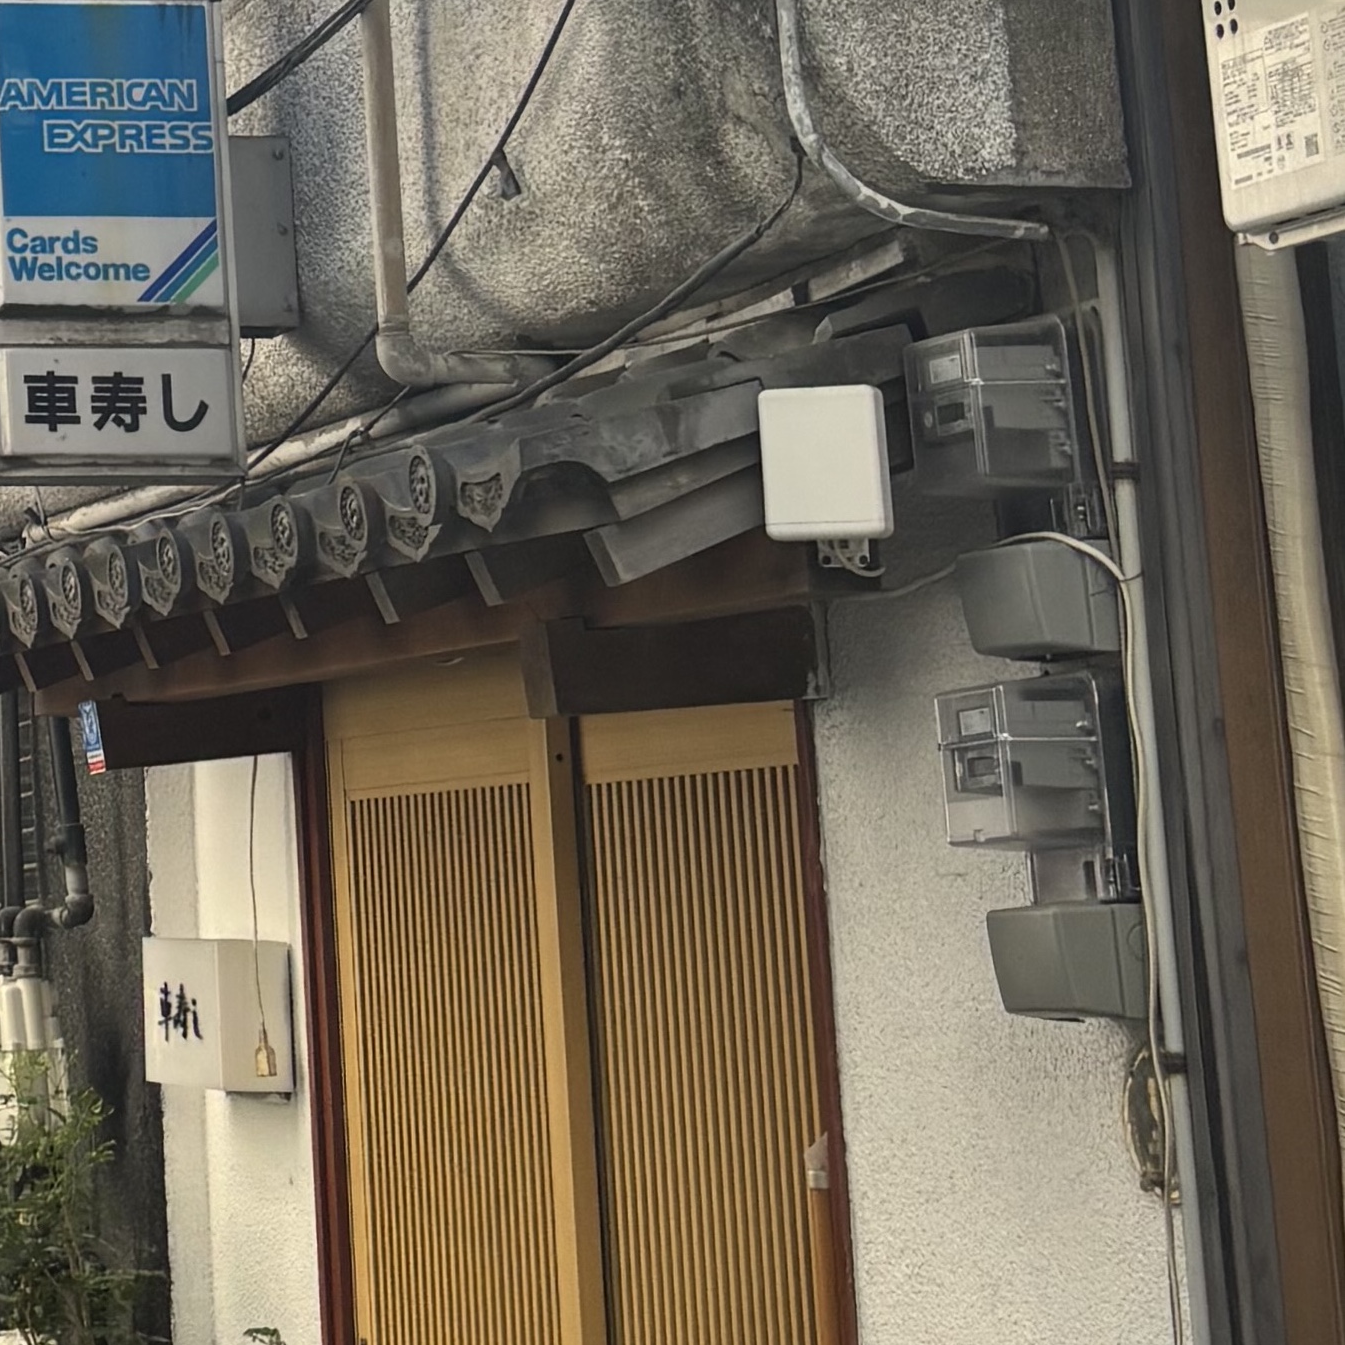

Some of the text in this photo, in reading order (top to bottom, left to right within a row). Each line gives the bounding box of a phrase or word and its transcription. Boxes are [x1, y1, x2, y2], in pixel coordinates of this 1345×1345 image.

[43, 119, 214, 153] EXPRESS
[6, 228, 98, 255] Cards
[8, 256, 151, 283] Welcome
[23, 371, 209, 433] 車寿し
